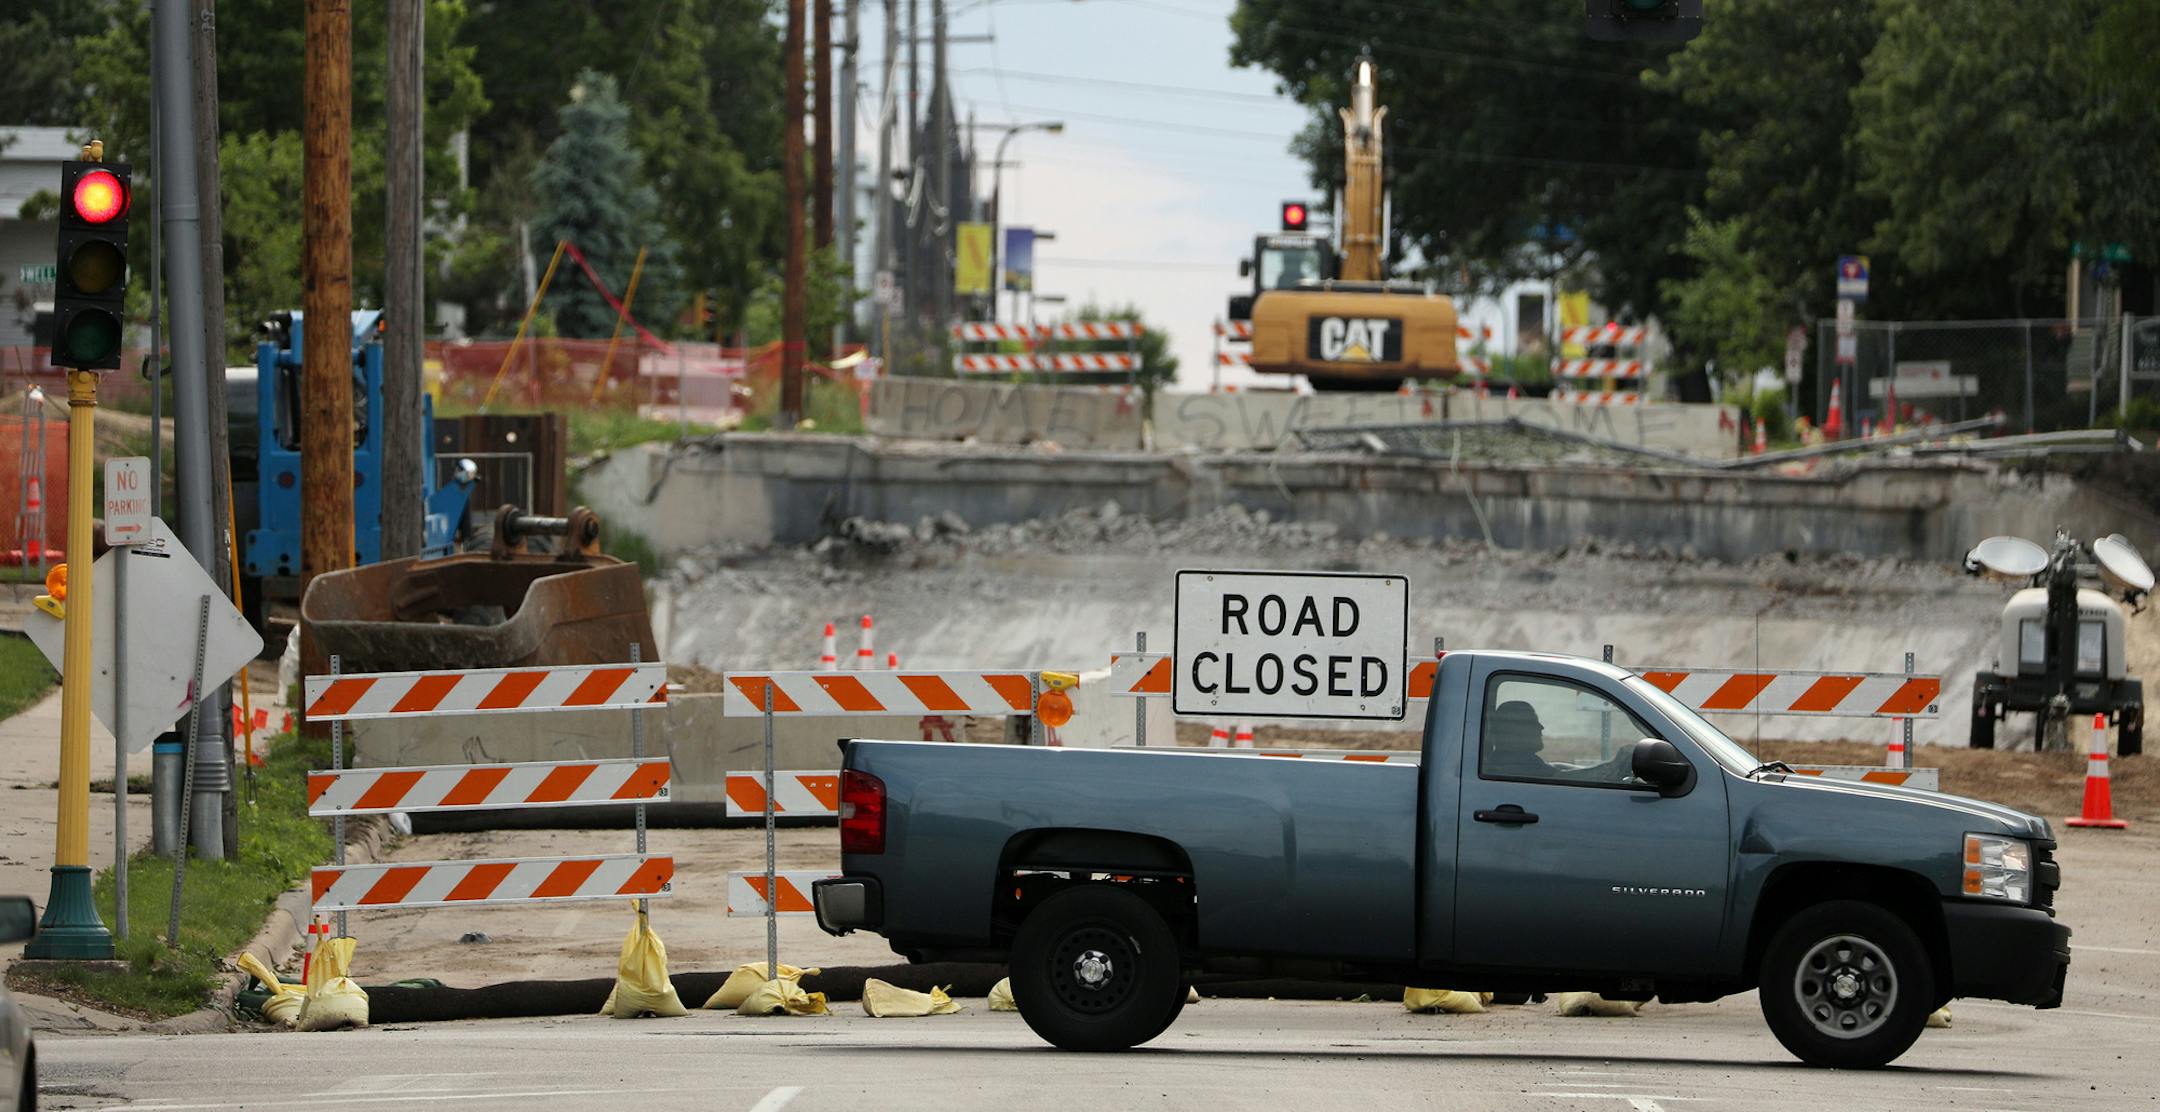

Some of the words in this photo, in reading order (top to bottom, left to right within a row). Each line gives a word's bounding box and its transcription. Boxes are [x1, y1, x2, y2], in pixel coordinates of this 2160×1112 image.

[1321, 317, 1390, 361] CAT
[901, 384, 1094, 438] HOME
[116, 470, 138, 491] NO
[108, 500, 149, 516] PARKING
[1222, 594, 1359, 637] ROAD
[1192, 651, 1388, 697] CLOSED
[1611, 886, 1705, 897] SILVERADO
